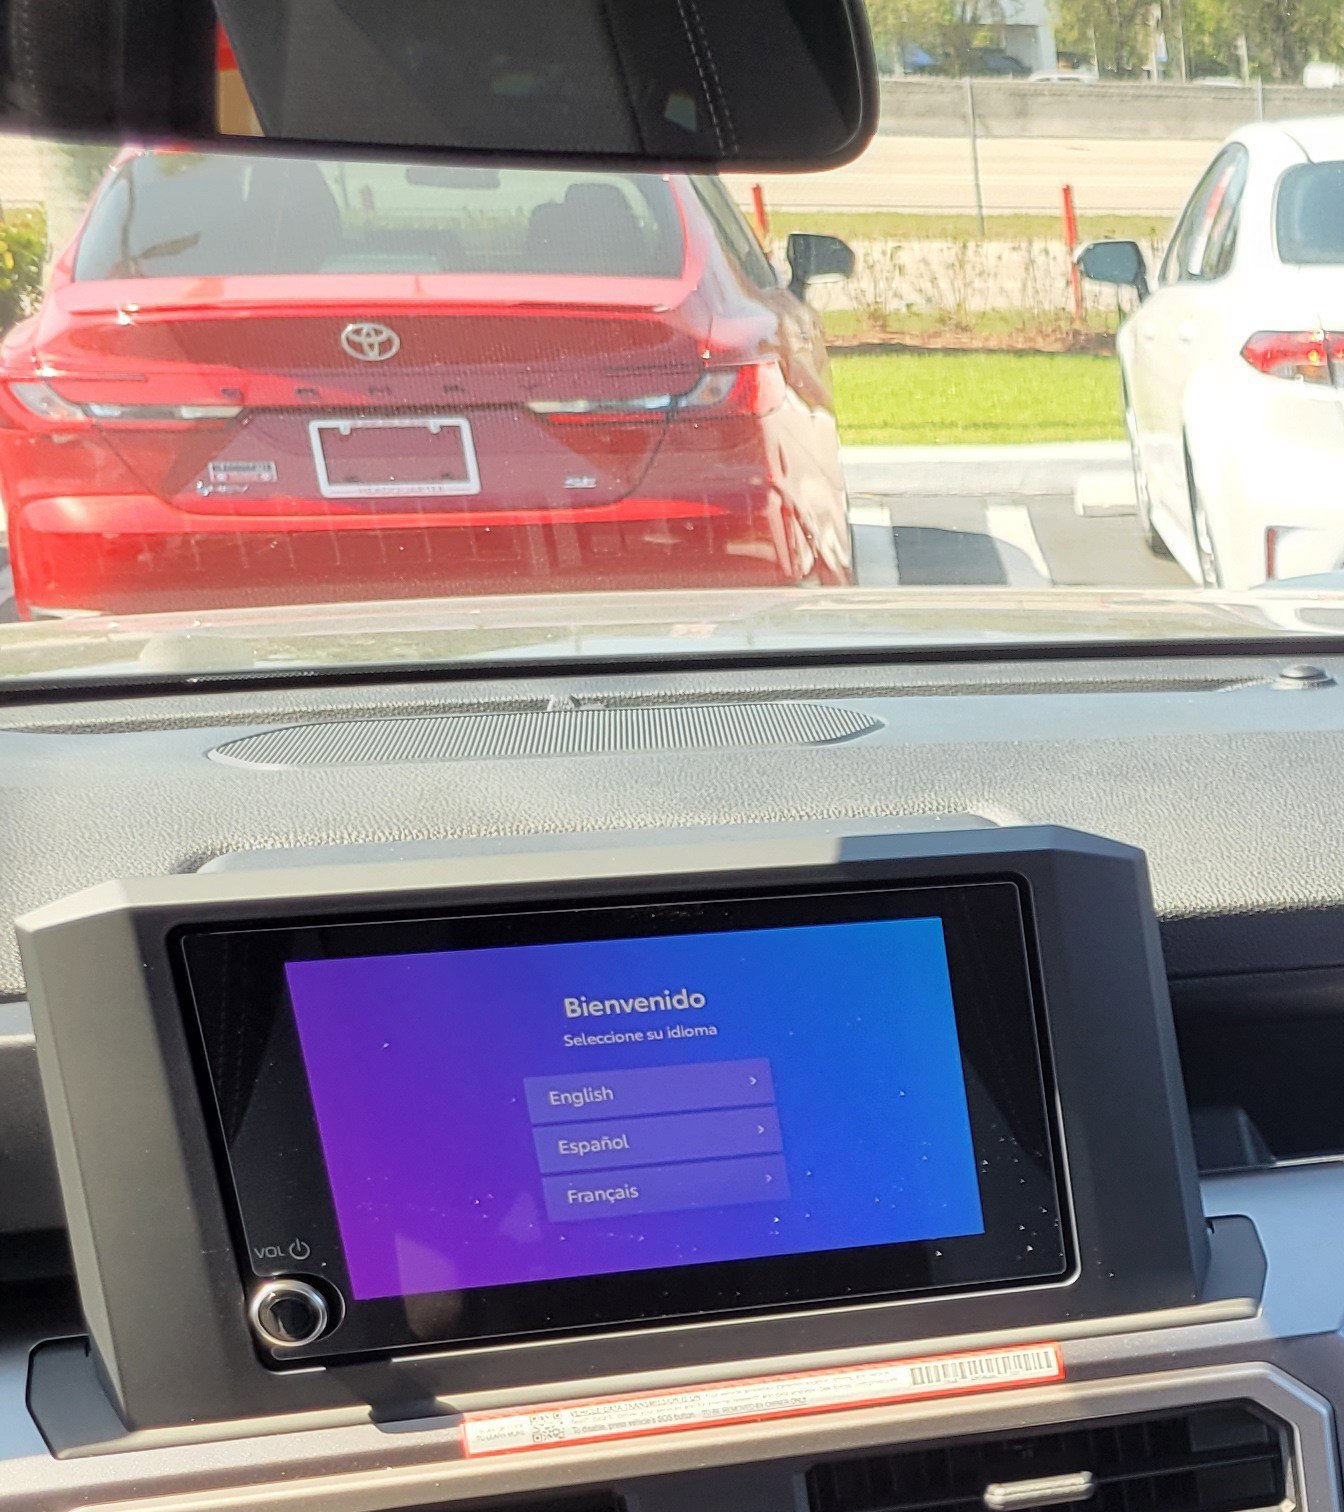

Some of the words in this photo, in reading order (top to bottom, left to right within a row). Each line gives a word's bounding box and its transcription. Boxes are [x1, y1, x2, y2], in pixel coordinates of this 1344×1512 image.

[564, 987, 706, 1019] Bienvenido
[563, 1030, 645, 1048] Seleccione
[646, 1028, 664, 1041] su
[666, 1024, 718, 1039] idioma
[549, 1085, 614, 1108] English
[558, 1134, 630, 1156] Español
[567, 1183, 639, 1204] Français
[254, 1246, 286, 1259] VOL
